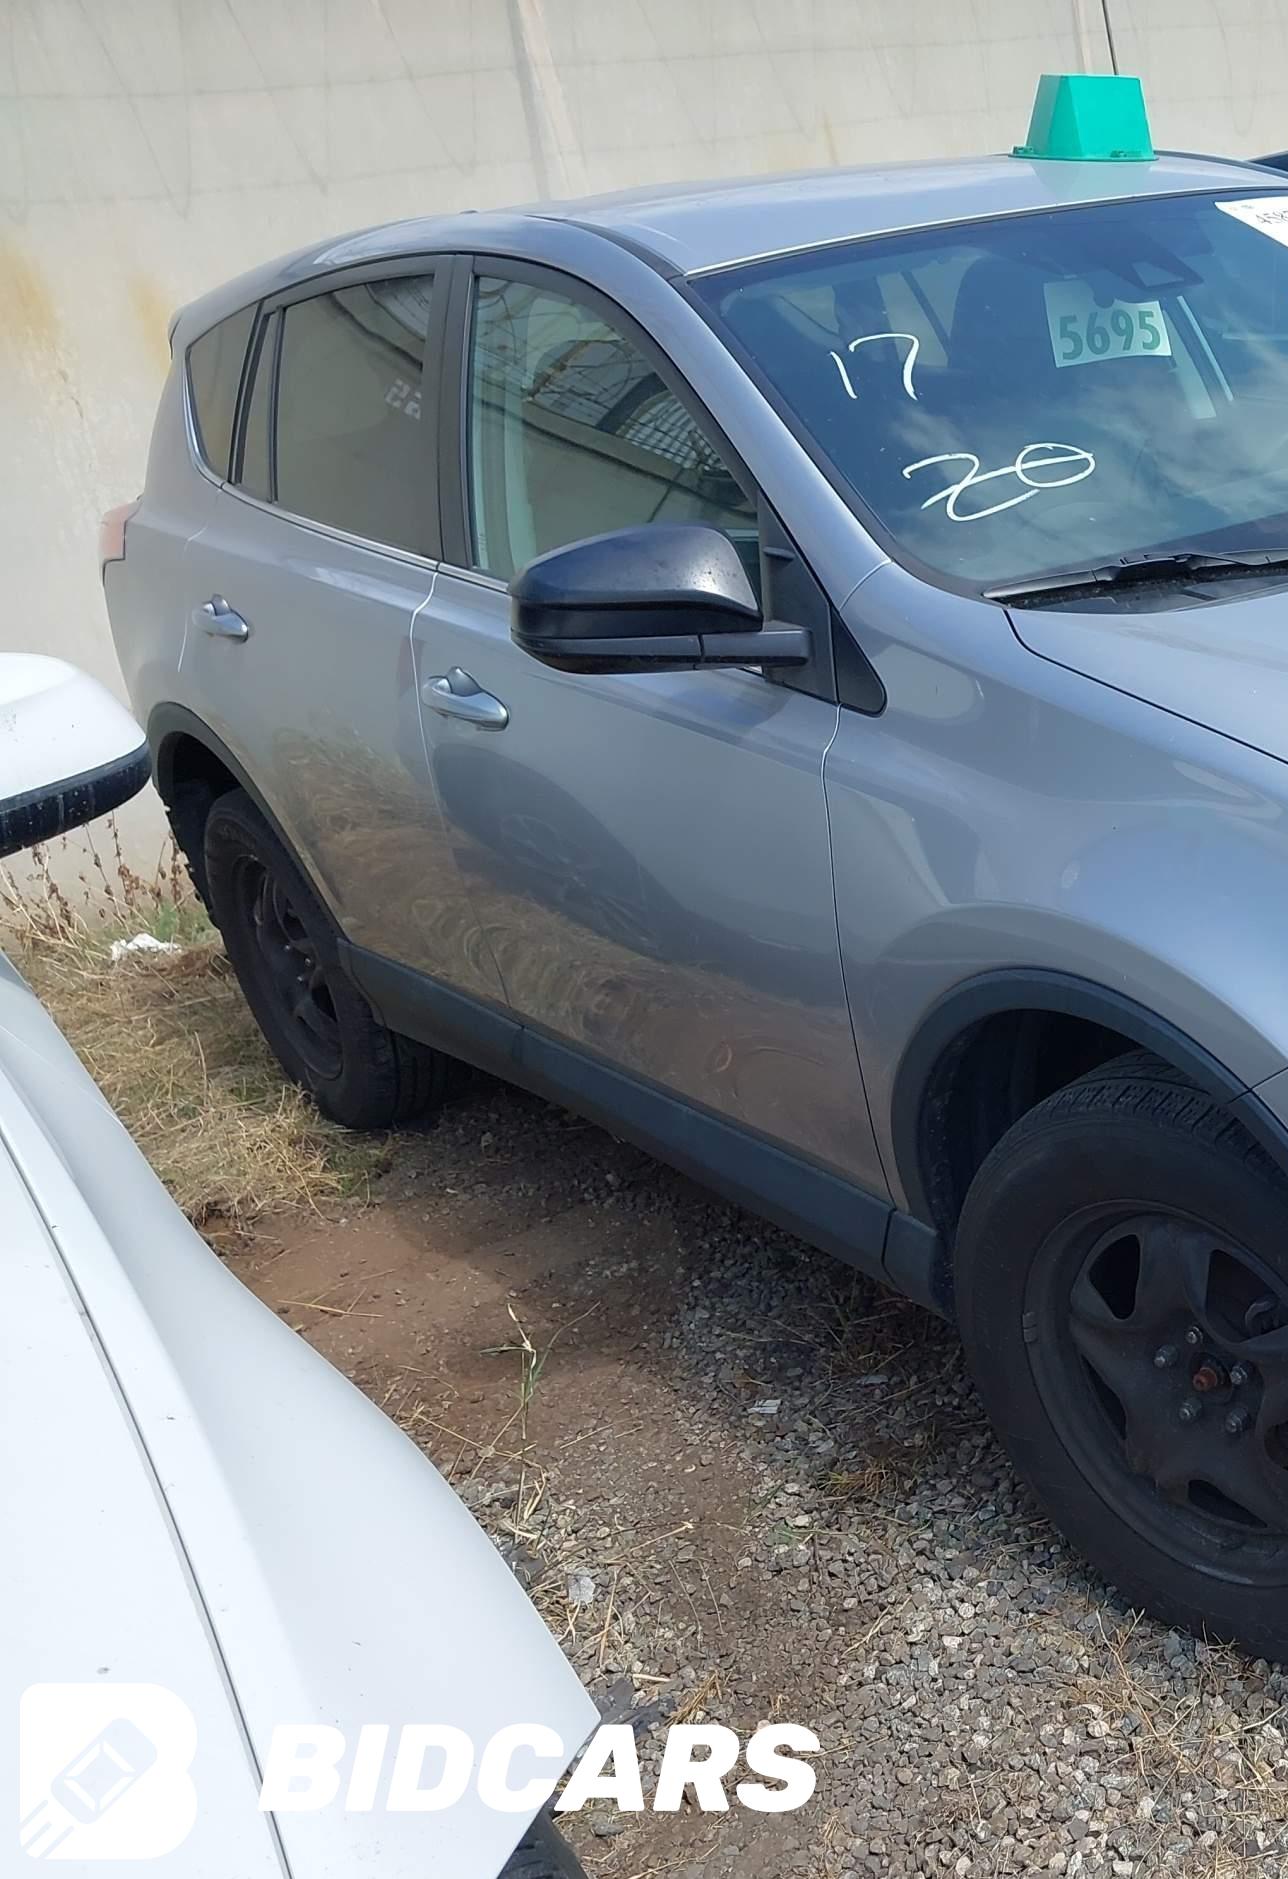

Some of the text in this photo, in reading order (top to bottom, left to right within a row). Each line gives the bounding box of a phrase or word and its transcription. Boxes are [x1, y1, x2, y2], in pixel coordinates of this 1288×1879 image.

[830, 332, 920, 401] 17
[1060, 309, 1161, 360] 5695
[902, 442, 1096, 522] 20
